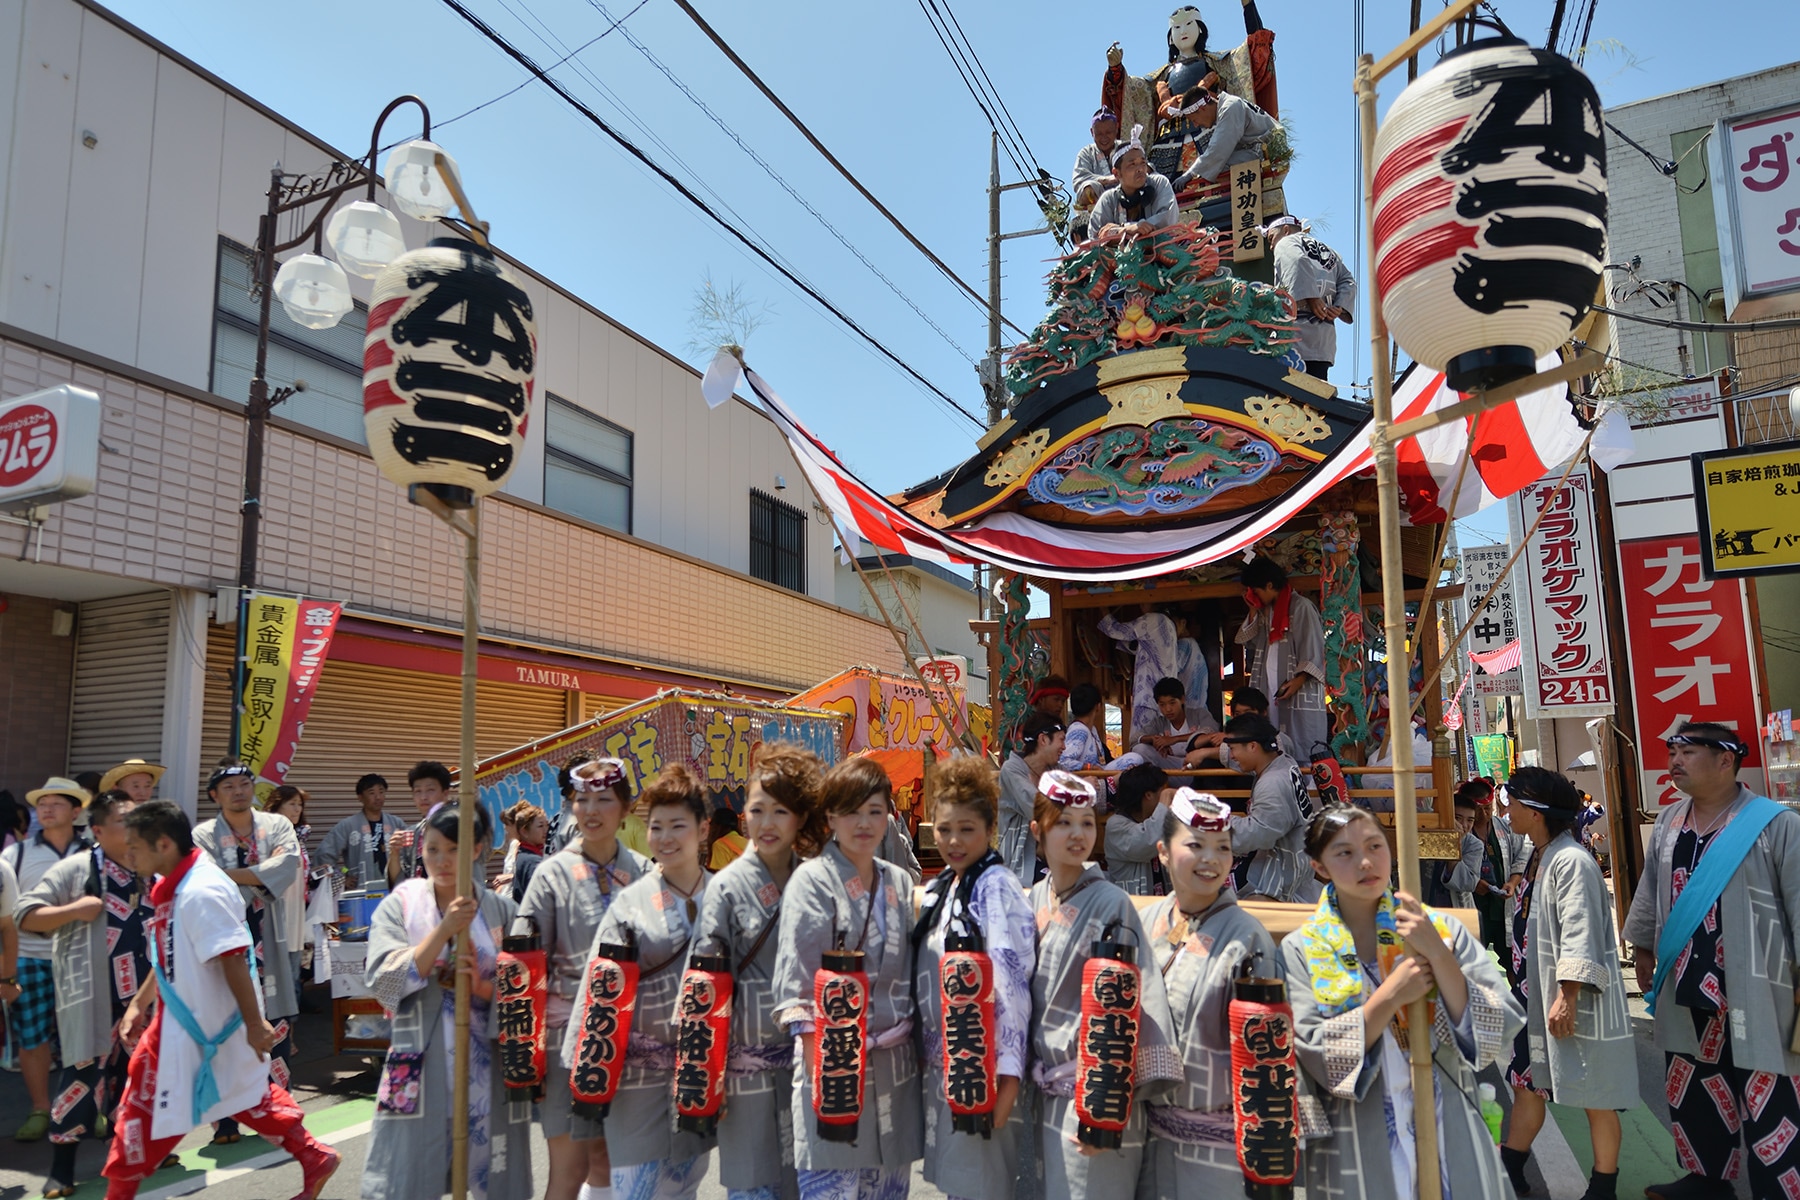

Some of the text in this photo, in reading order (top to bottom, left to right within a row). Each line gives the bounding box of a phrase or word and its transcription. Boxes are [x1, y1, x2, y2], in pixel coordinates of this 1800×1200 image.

[1740, 131, 1800, 192] ダ
[1236, 170, 1258, 250] 神功皇后
[1708, 462, 1800, 486] 自家焙煎珈
[1774, 482, 1788, 497] &
[1535, 486, 1591, 673] カラオケマック
[253, 604, 287, 666] 貴金属
[516, 666, 581, 689] TAMURA
[1541, 679, 1608, 704] 24h
[497, 999, 537, 1083] 瑞恵
[575, 1003, 618, 1093] あかね
[821, 1024, 862, 1115] 愛里
[946, 1003, 987, 1107] 美希
[1085, 1013, 1137, 1122] 若者
[1241, 1064, 1297, 1178] 若者
